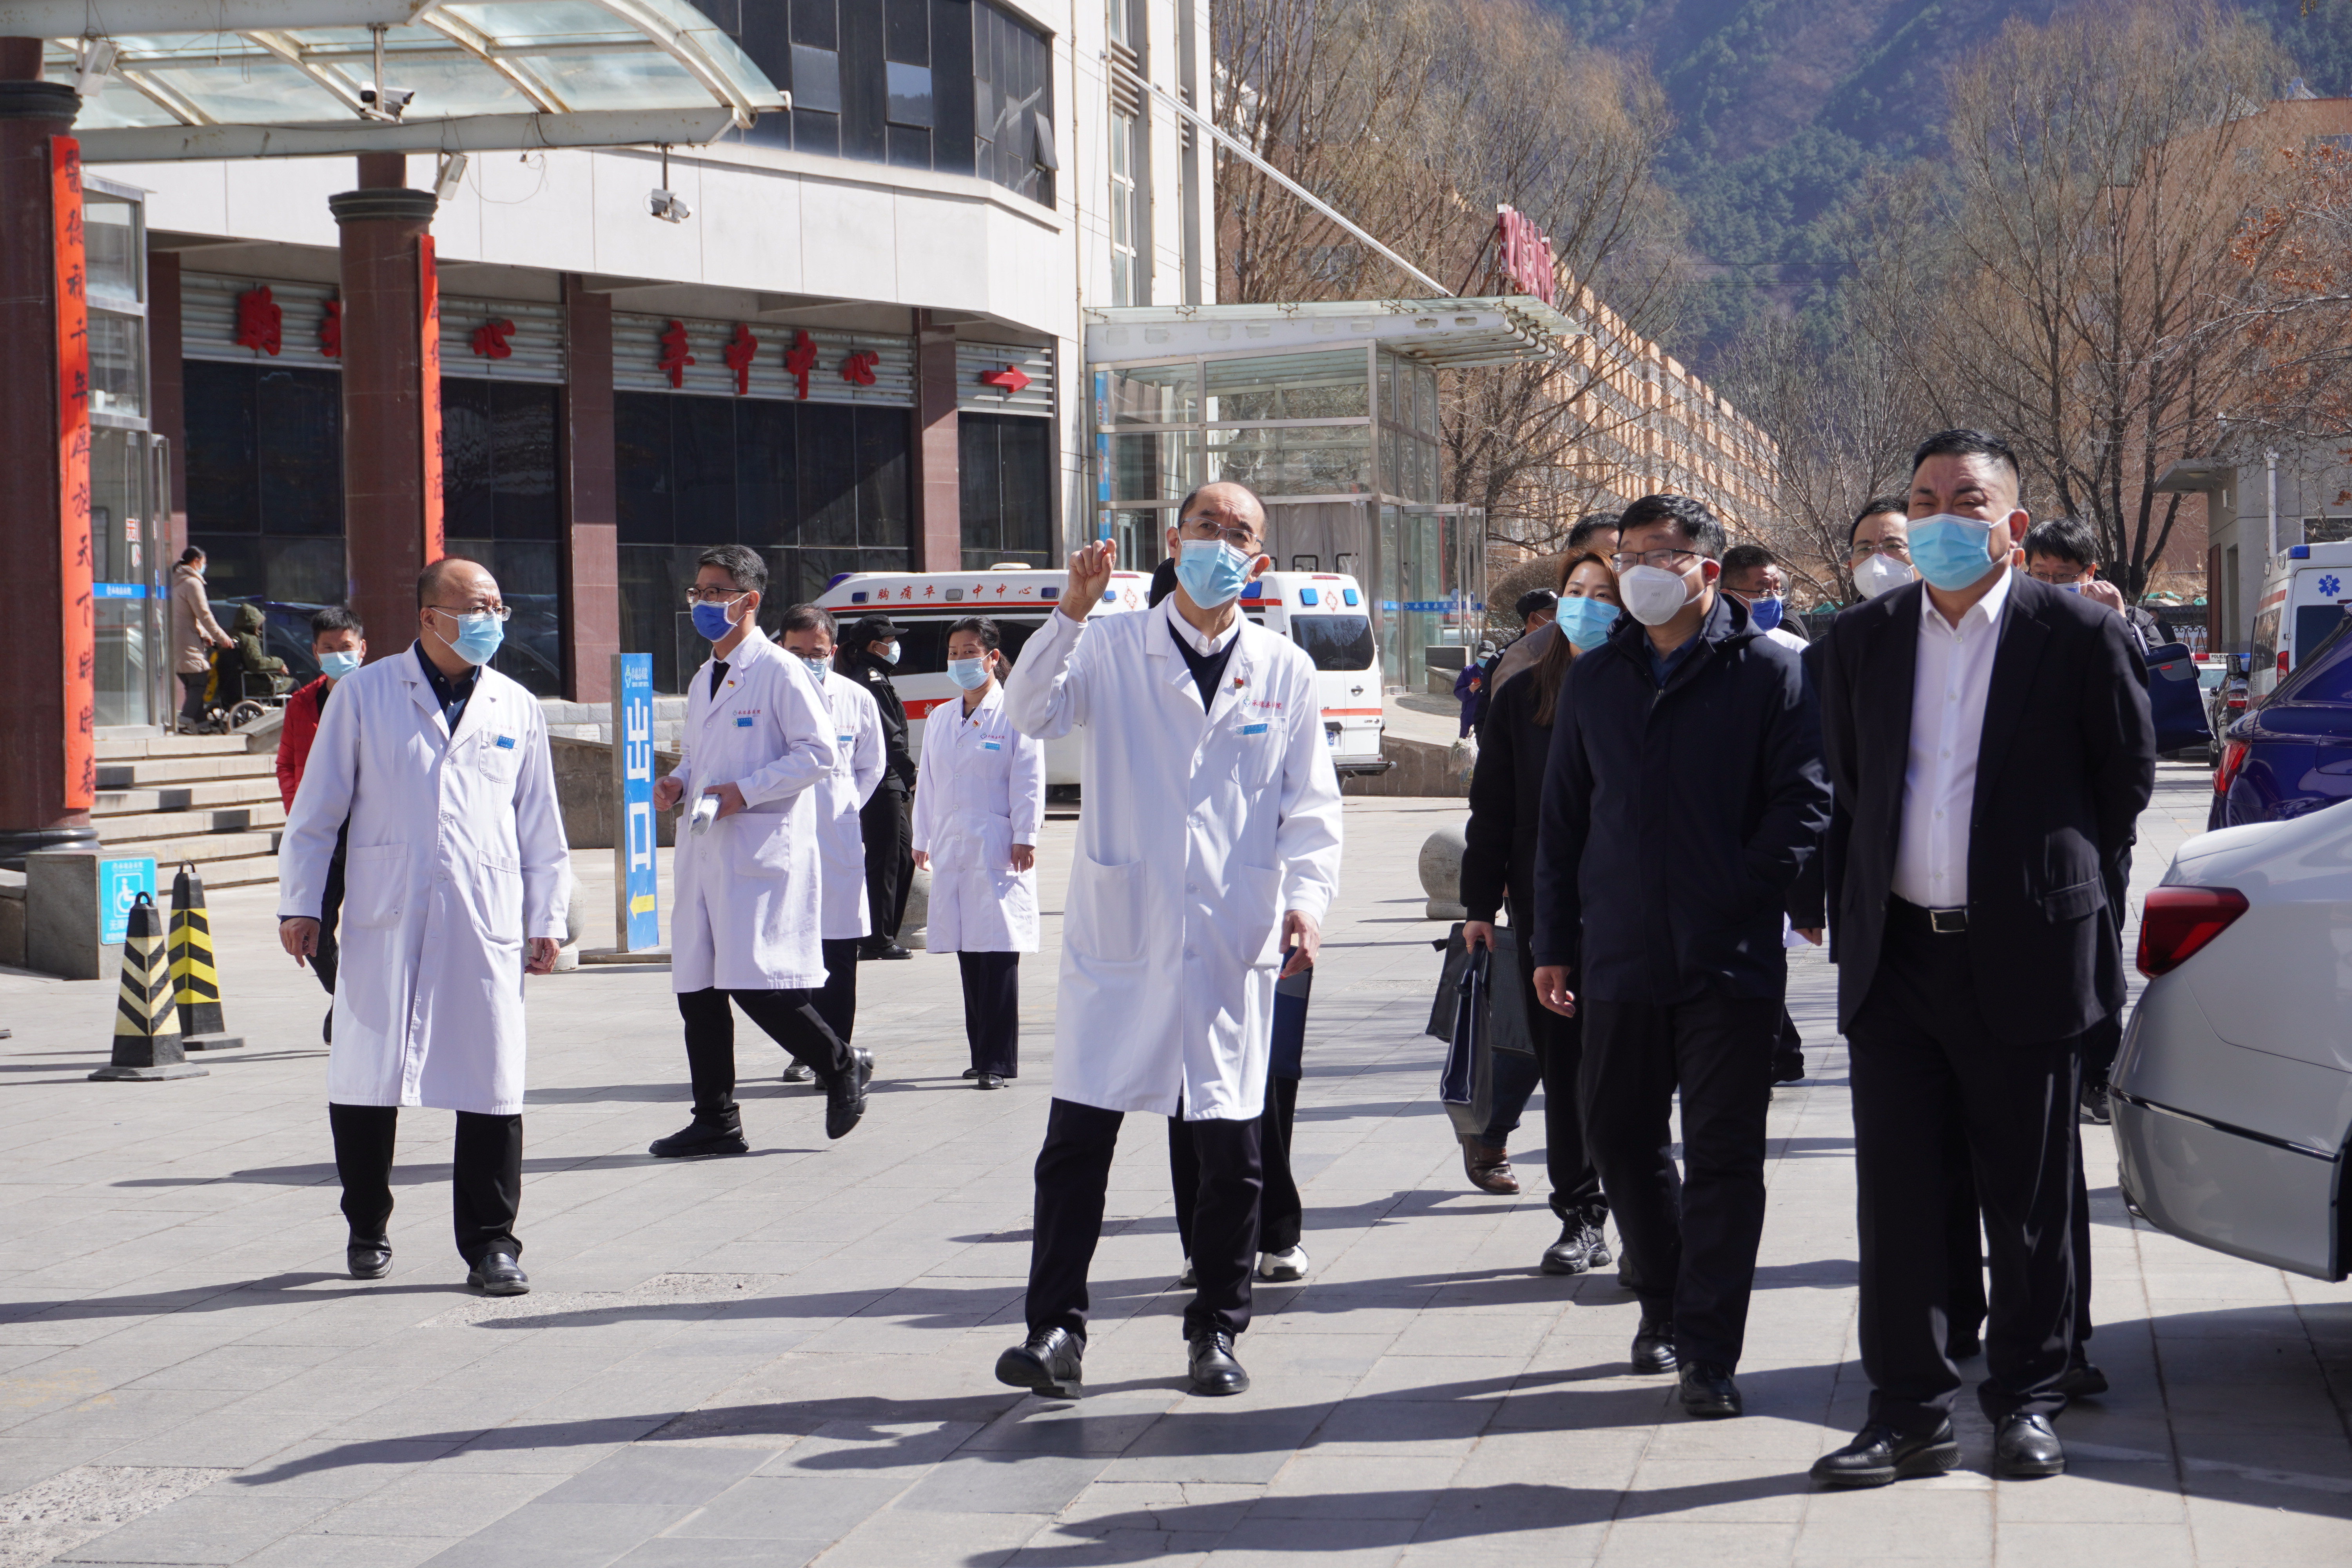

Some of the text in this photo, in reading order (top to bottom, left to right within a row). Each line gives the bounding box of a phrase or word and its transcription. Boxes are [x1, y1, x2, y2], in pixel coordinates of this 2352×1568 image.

[658, 320, 879, 400] 卒中中心
[877, 583, 1032, 600] 胸痛卒中中心
[627, 697, 651, 873] 出口
